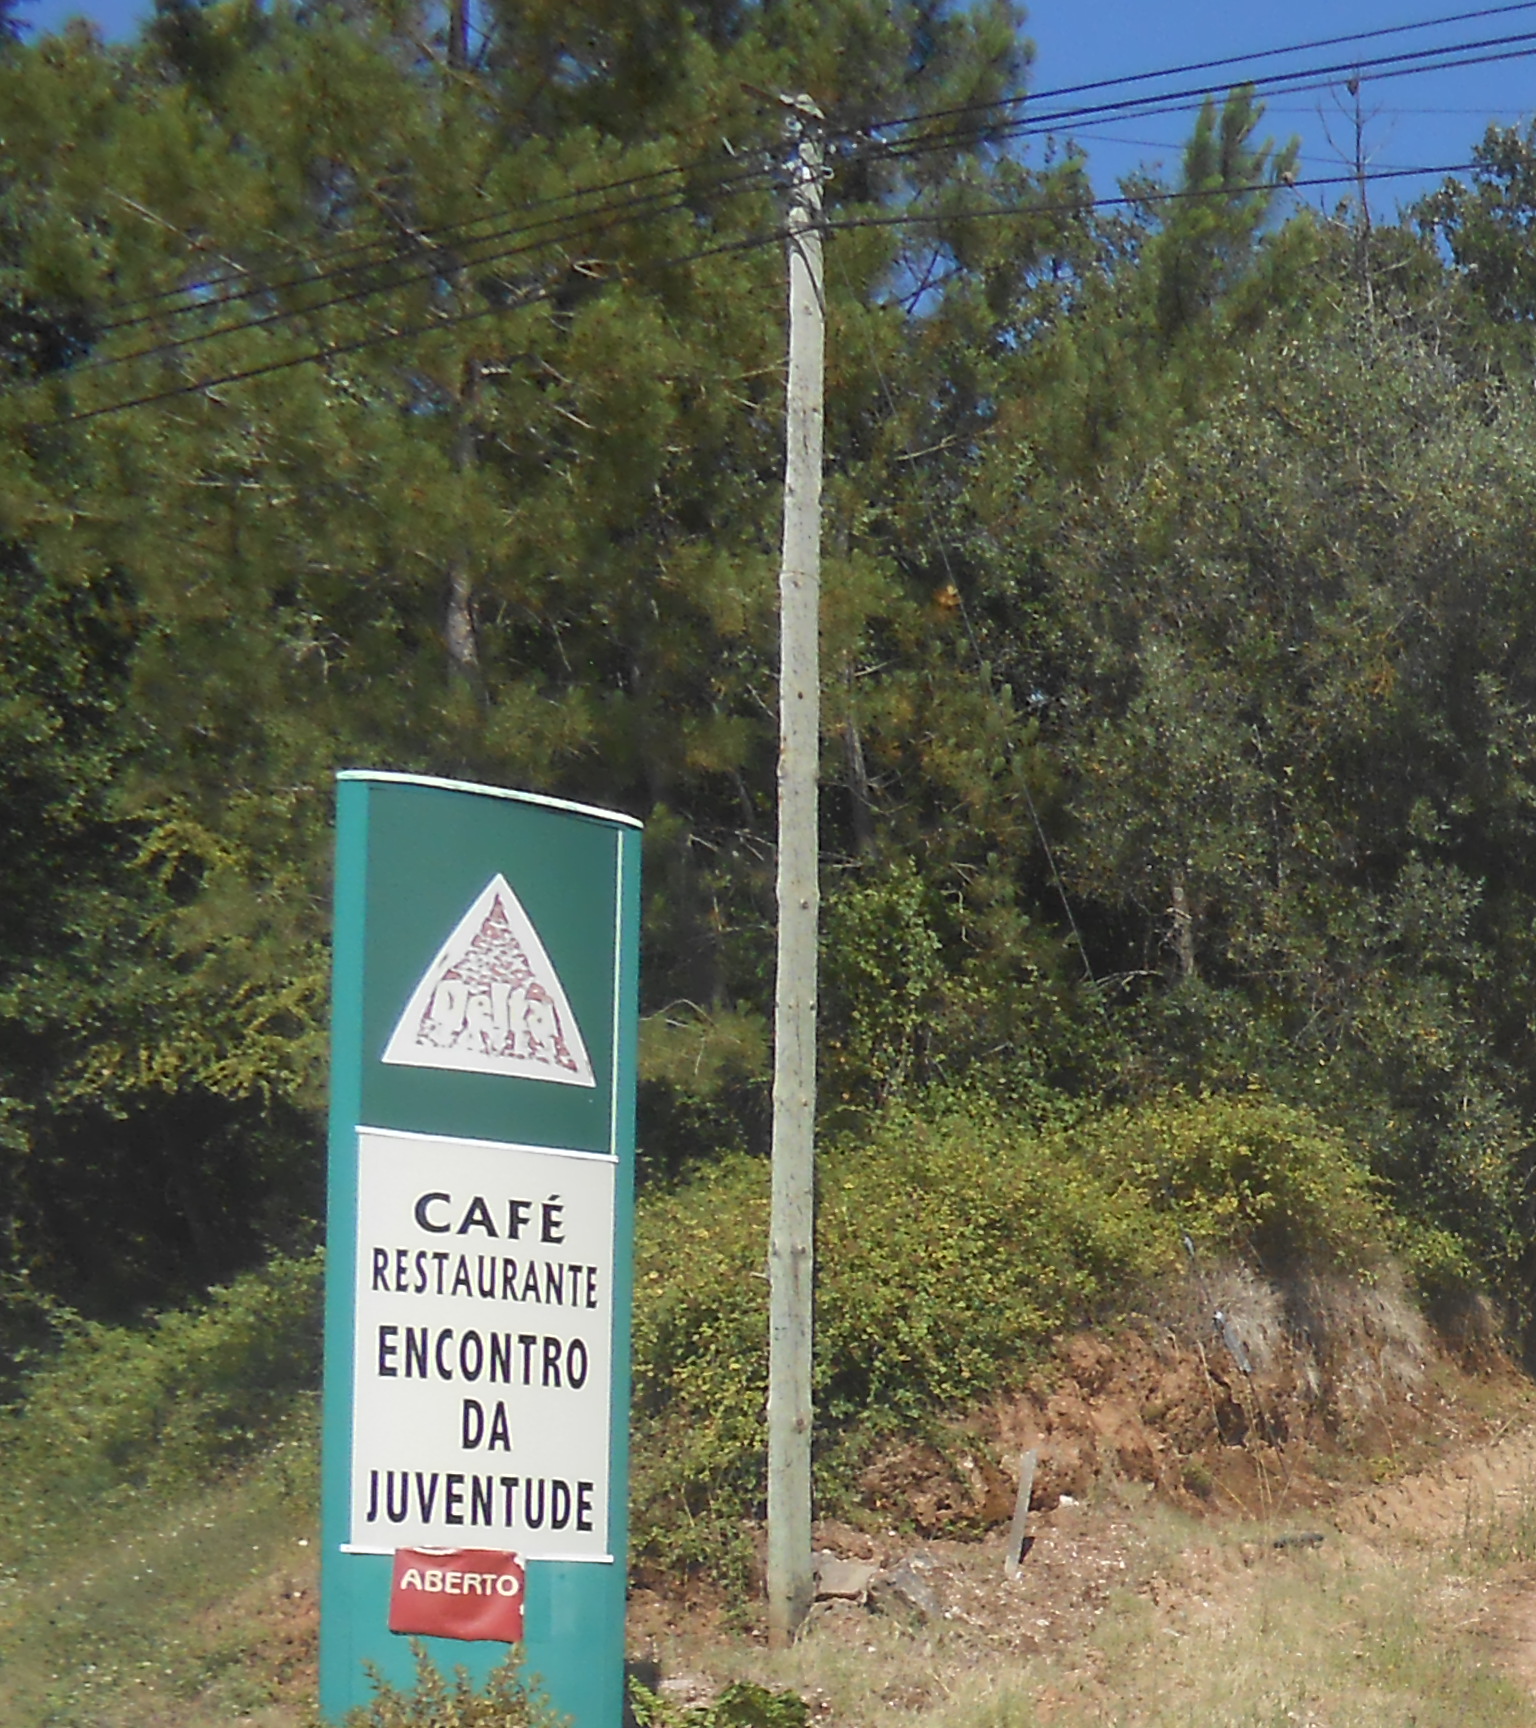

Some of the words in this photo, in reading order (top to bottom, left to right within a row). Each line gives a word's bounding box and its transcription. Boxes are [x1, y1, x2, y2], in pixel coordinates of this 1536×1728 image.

[414, 1192, 566, 1244] CAFÉ
[372, 1247, 598, 1309] RESTAURANTE
[378, 1325, 588, 1389] ENCONTRO
[462, 1398, 511, 1452] DA
[366, 1470, 594, 1532] JUVENTUDE
[400, 1568, 520, 1597] ABERTO
